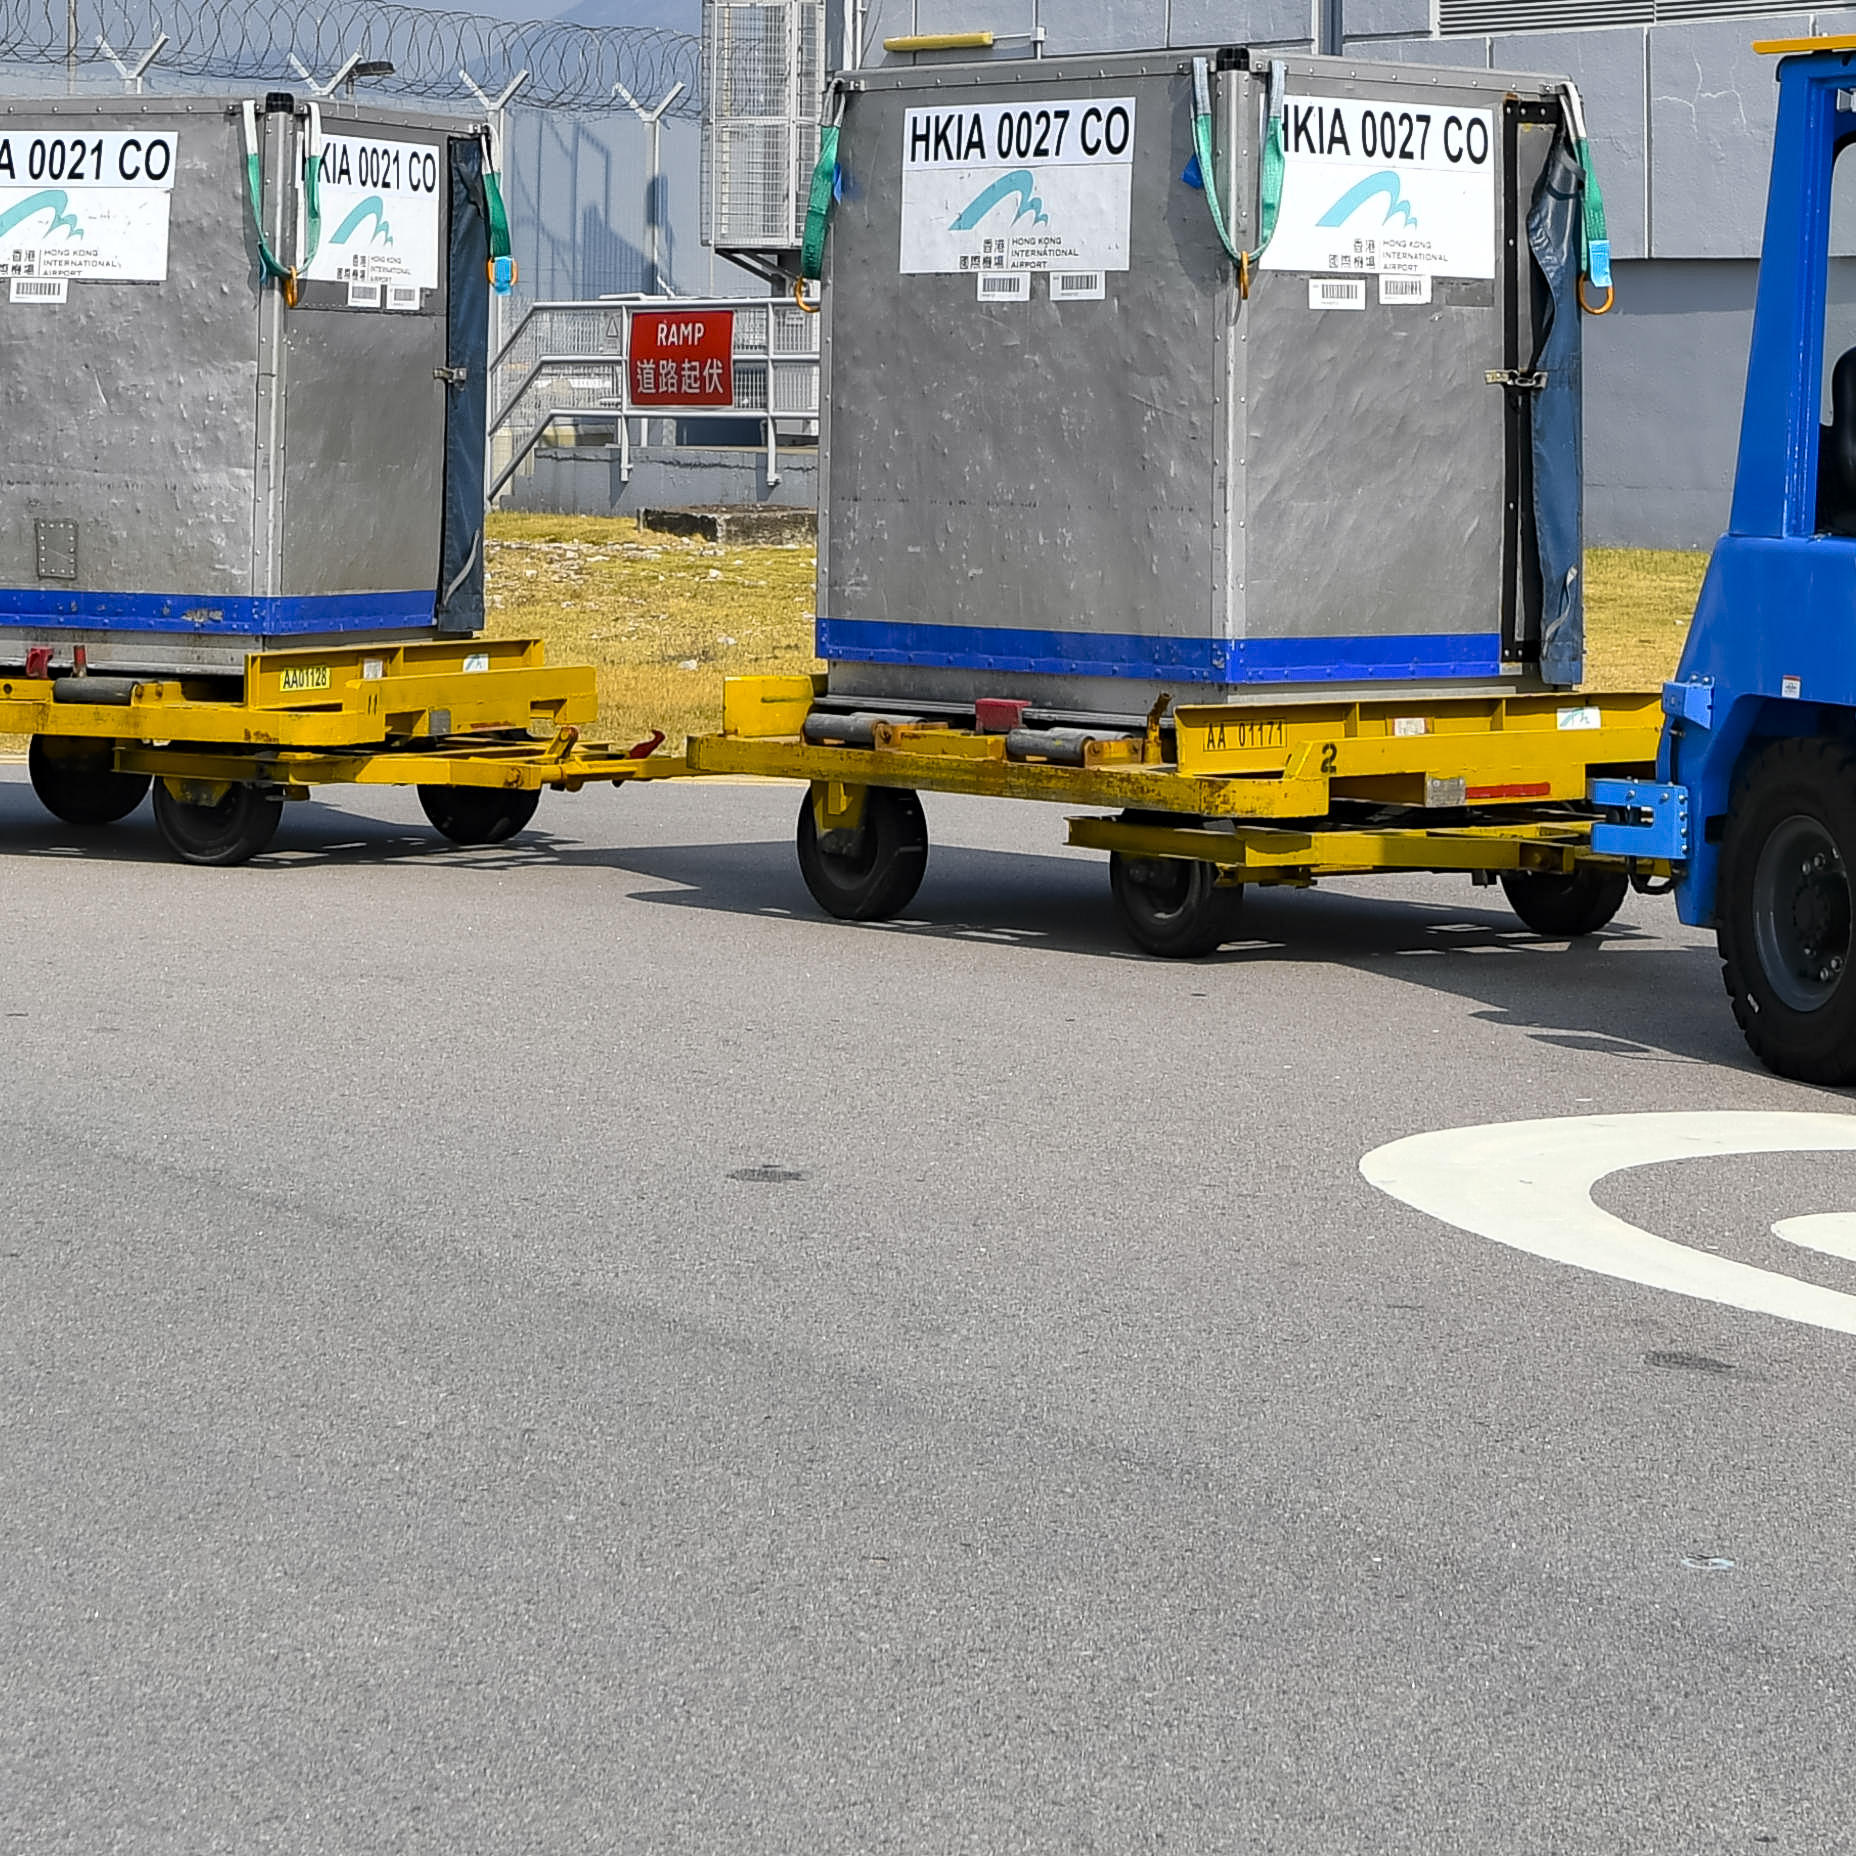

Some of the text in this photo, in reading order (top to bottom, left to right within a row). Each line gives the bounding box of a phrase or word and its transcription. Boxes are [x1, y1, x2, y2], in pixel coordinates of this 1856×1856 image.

[910, 105, 1130, 162] HKIA 0027 CO
[1361, 110, 1431, 160] 0027
[1443, 115, 1488, 165] CO
[28, 138, 104, 180] 0021
[118, 138, 171, 181] CO
[358, 146, 400, 190] 0021
[408, 151, 436, 193] CO
[1012, 236, 1062, 245] HONG KONG
[43, 260, 116, 268] INTERNATIONAL
[44, 249, 98, 257] HONG KONG
[1011, 248, 1079, 257] INTERNATIONAL
[1382, 252, 1448, 262] INTERNATIONAL
[1011, 261, 1047, 269] AIRPORT
[1383, 263, 1418, 272] AIRPORT
[657, 322, 705, 346] RAMP
[636, 358, 724, 394] 道路起伏
[282, 667, 327, 689] AA01128
[1207, 720, 1283, 749] AA 01171
[1320, 743, 1337, 774] 2
